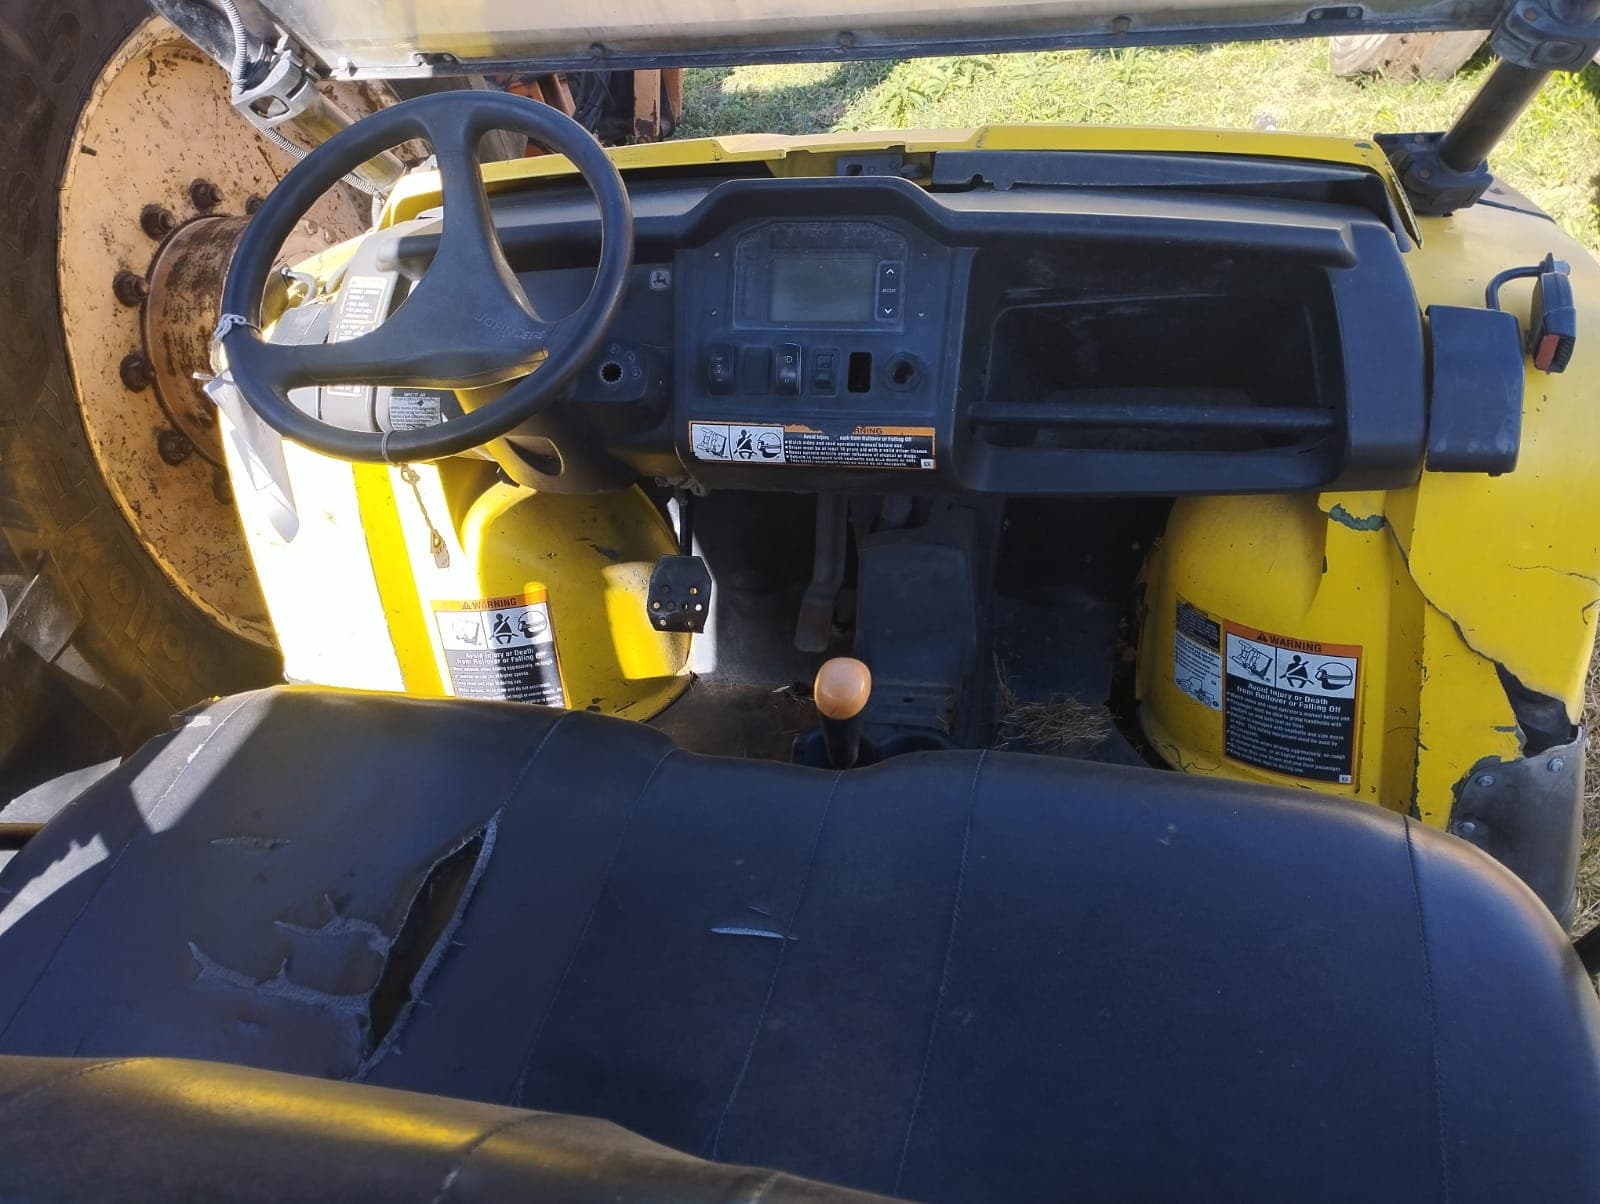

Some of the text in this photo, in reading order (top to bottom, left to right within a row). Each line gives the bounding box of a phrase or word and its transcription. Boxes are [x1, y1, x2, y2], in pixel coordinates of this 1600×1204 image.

[472, 597, 517, 609] WARNING
[1270, 634, 1322, 653] WARNING
[511, 654, 534, 662] Falling
[514, 648, 534, 656] Death
[1237, 686, 1254, 696] from
[1256, 691, 1287, 705] Rollover
[1299, 702, 1327, 713] Falling
[1329, 705, 1341, 713] Off
[1248, 683, 1269, 694] Avoid
[1270, 689, 1293, 701] Injury
[1304, 696, 1328, 705] Death
